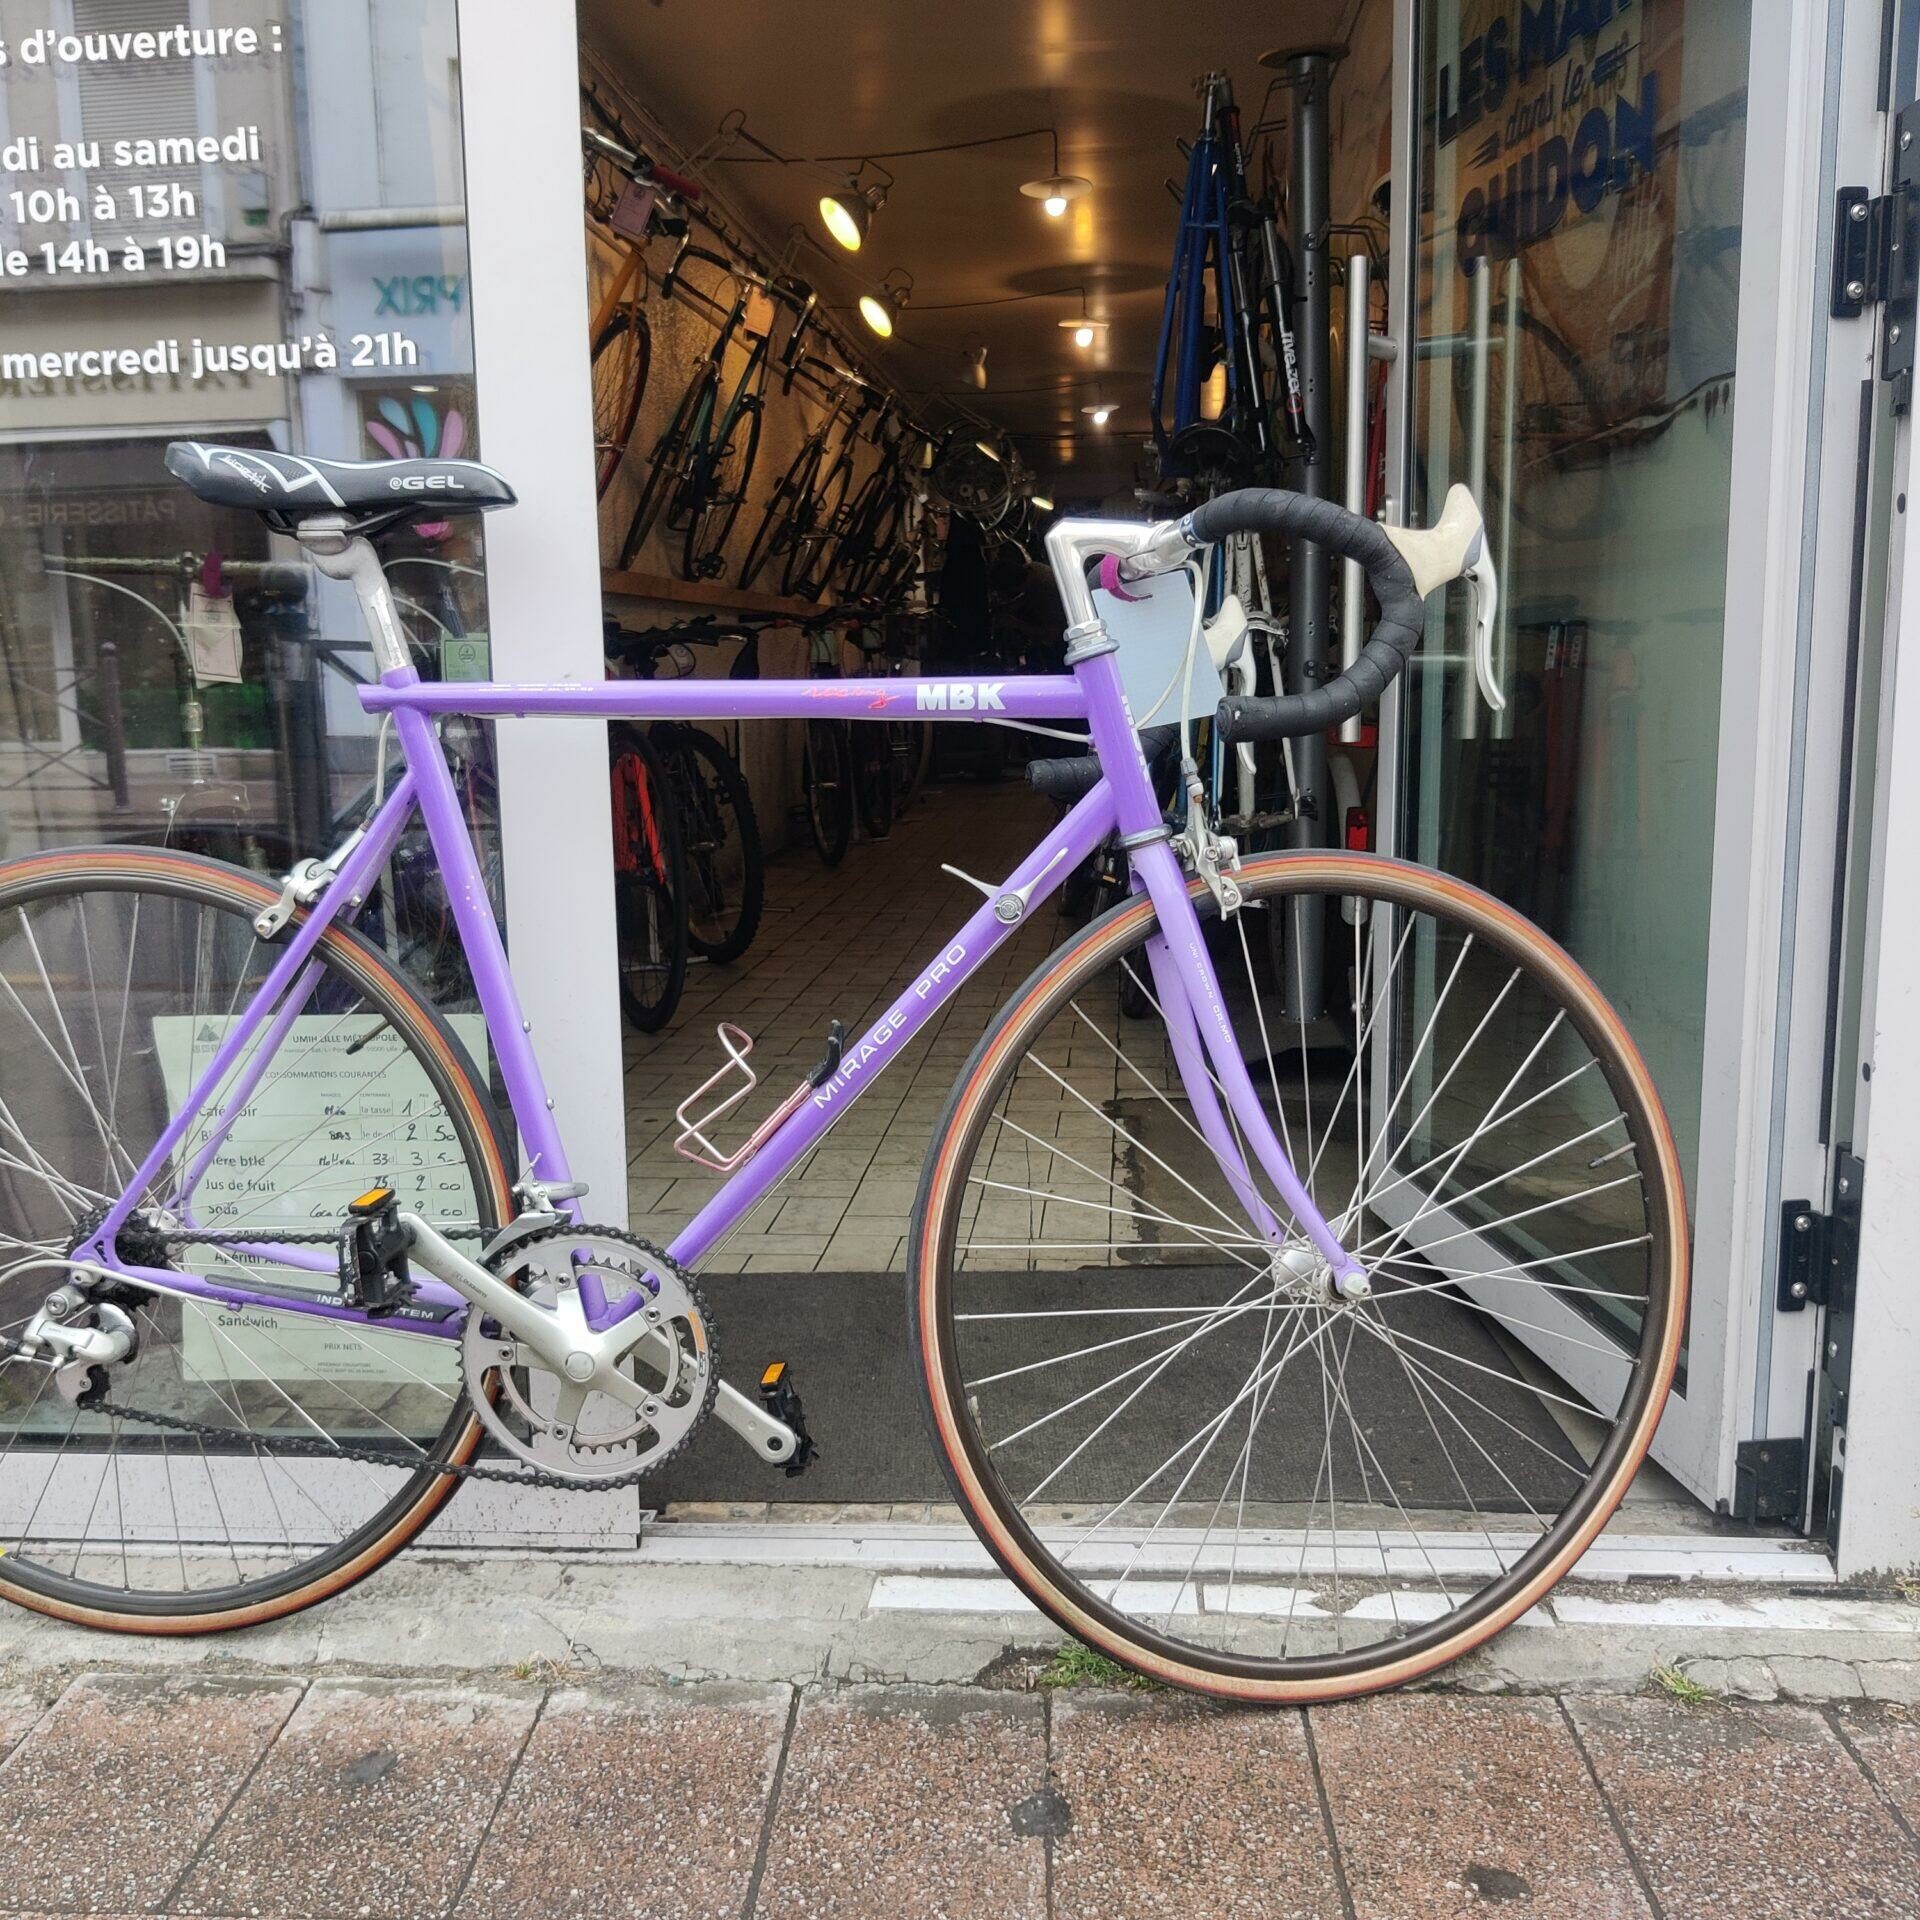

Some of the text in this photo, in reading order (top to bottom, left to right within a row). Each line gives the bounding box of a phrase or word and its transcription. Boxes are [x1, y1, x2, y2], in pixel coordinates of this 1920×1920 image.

[20, 24, 258, 65] d'ouverture
[53, 141, 99, 169] au
[114, 127, 260, 166] samedi
[10, 182, 196, 224] 10h à 13h
[41, 240, 109, 273] 14h
[123, 237, 145, 271] à
[157, 234, 225, 269] 19h
[3, 332, 417, 378] mercredi jusqu'à 21h
[915, 683, 1006, 711] MBK
[813, 944, 966, 1109] MIRAGE PRO
[239, 1105, 258, 1117] oir
[402, 1098, 412, 1116] 1
[406, 1122, 418, 1141] 2
[434, 1124, 456, 1141] 50
[410, 1151, 423, 1165] 3
[206, 1178, 225, 1190] Jus
[228, 1178, 244, 1190] de
[247, 1178, 276, 1192] fruit
[208, 1203, 239, 1216] Soda
[218, 1315, 278, 1329] Sandwich
[324, 1342, 345, 1351] PRIX
